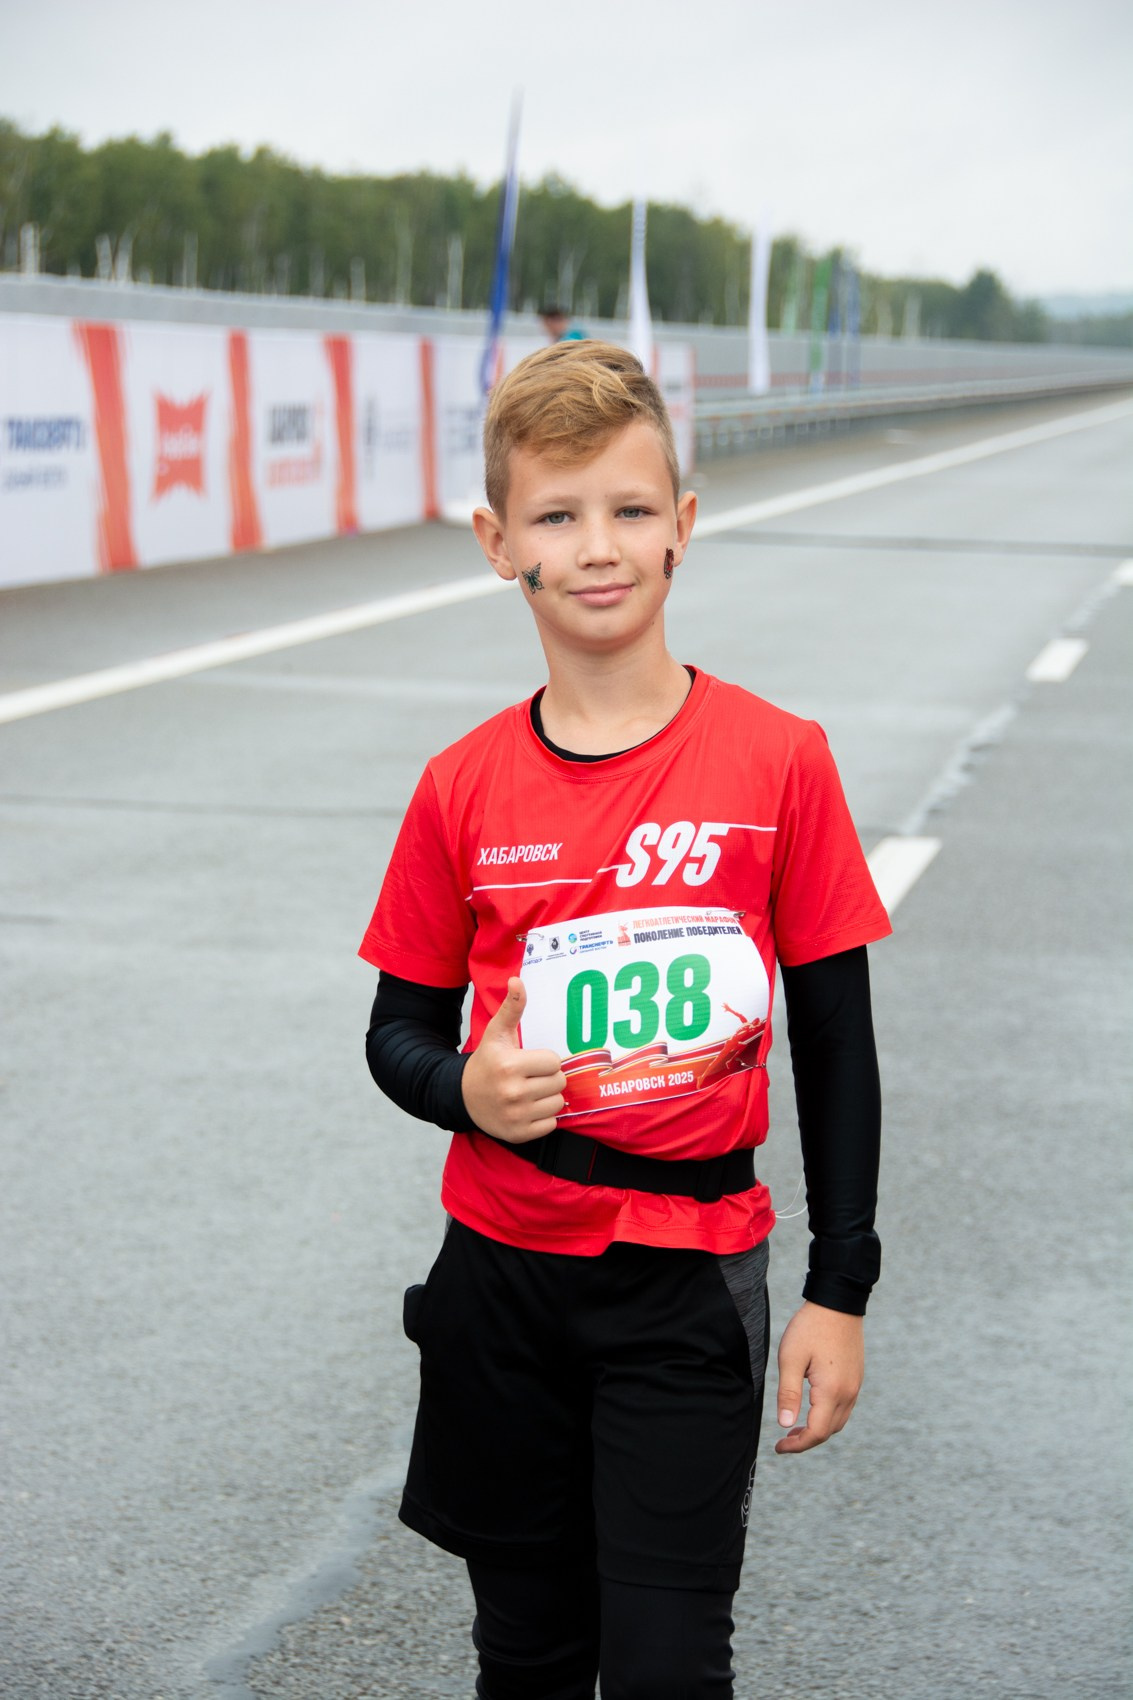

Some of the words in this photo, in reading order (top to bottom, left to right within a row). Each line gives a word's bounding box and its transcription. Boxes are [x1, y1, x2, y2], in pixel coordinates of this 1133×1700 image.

[477, 843, 563, 865] ХАБАРОВСК
[616, 821, 730, 887] S95
[633, 915, 704, 929] ЛЕГКОАТЛЕТИЧЕСКИЙ
[634, 928, 685, 943] ПОКОЛЕНИЕ
[687, 925, 742, 936] ПОБЕДИТЕЛЕЙ
[566, 953, 711, 1055] 038
[599, 1075, 665, 1098] ХАБАРОВСК
[668, 1071, 694, 1087] 2025
